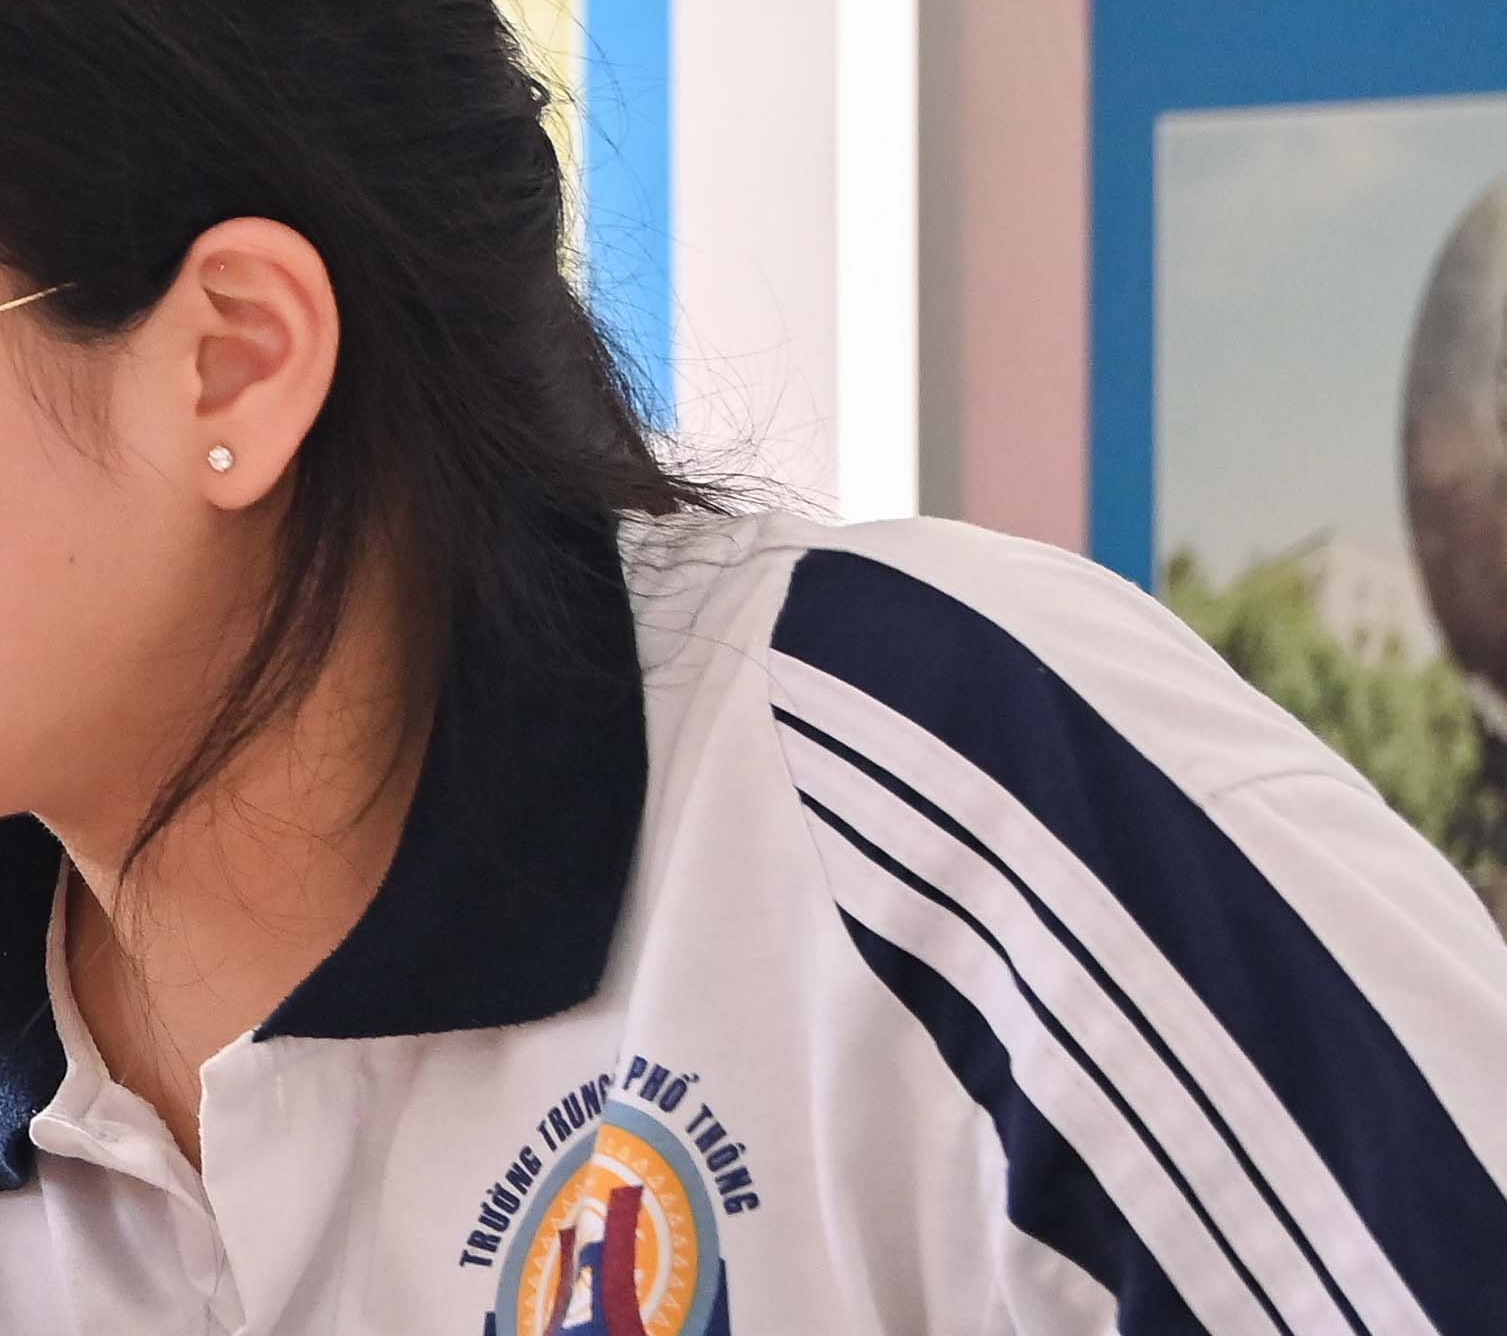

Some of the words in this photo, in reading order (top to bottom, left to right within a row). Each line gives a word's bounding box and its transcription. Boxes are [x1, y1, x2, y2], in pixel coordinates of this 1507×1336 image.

[623, 1056, 699, 1113] PHỔ
[687, 1102, 760, 1216] THÔNG
[460, 1146, 543, 1268] TRƯỜNG
